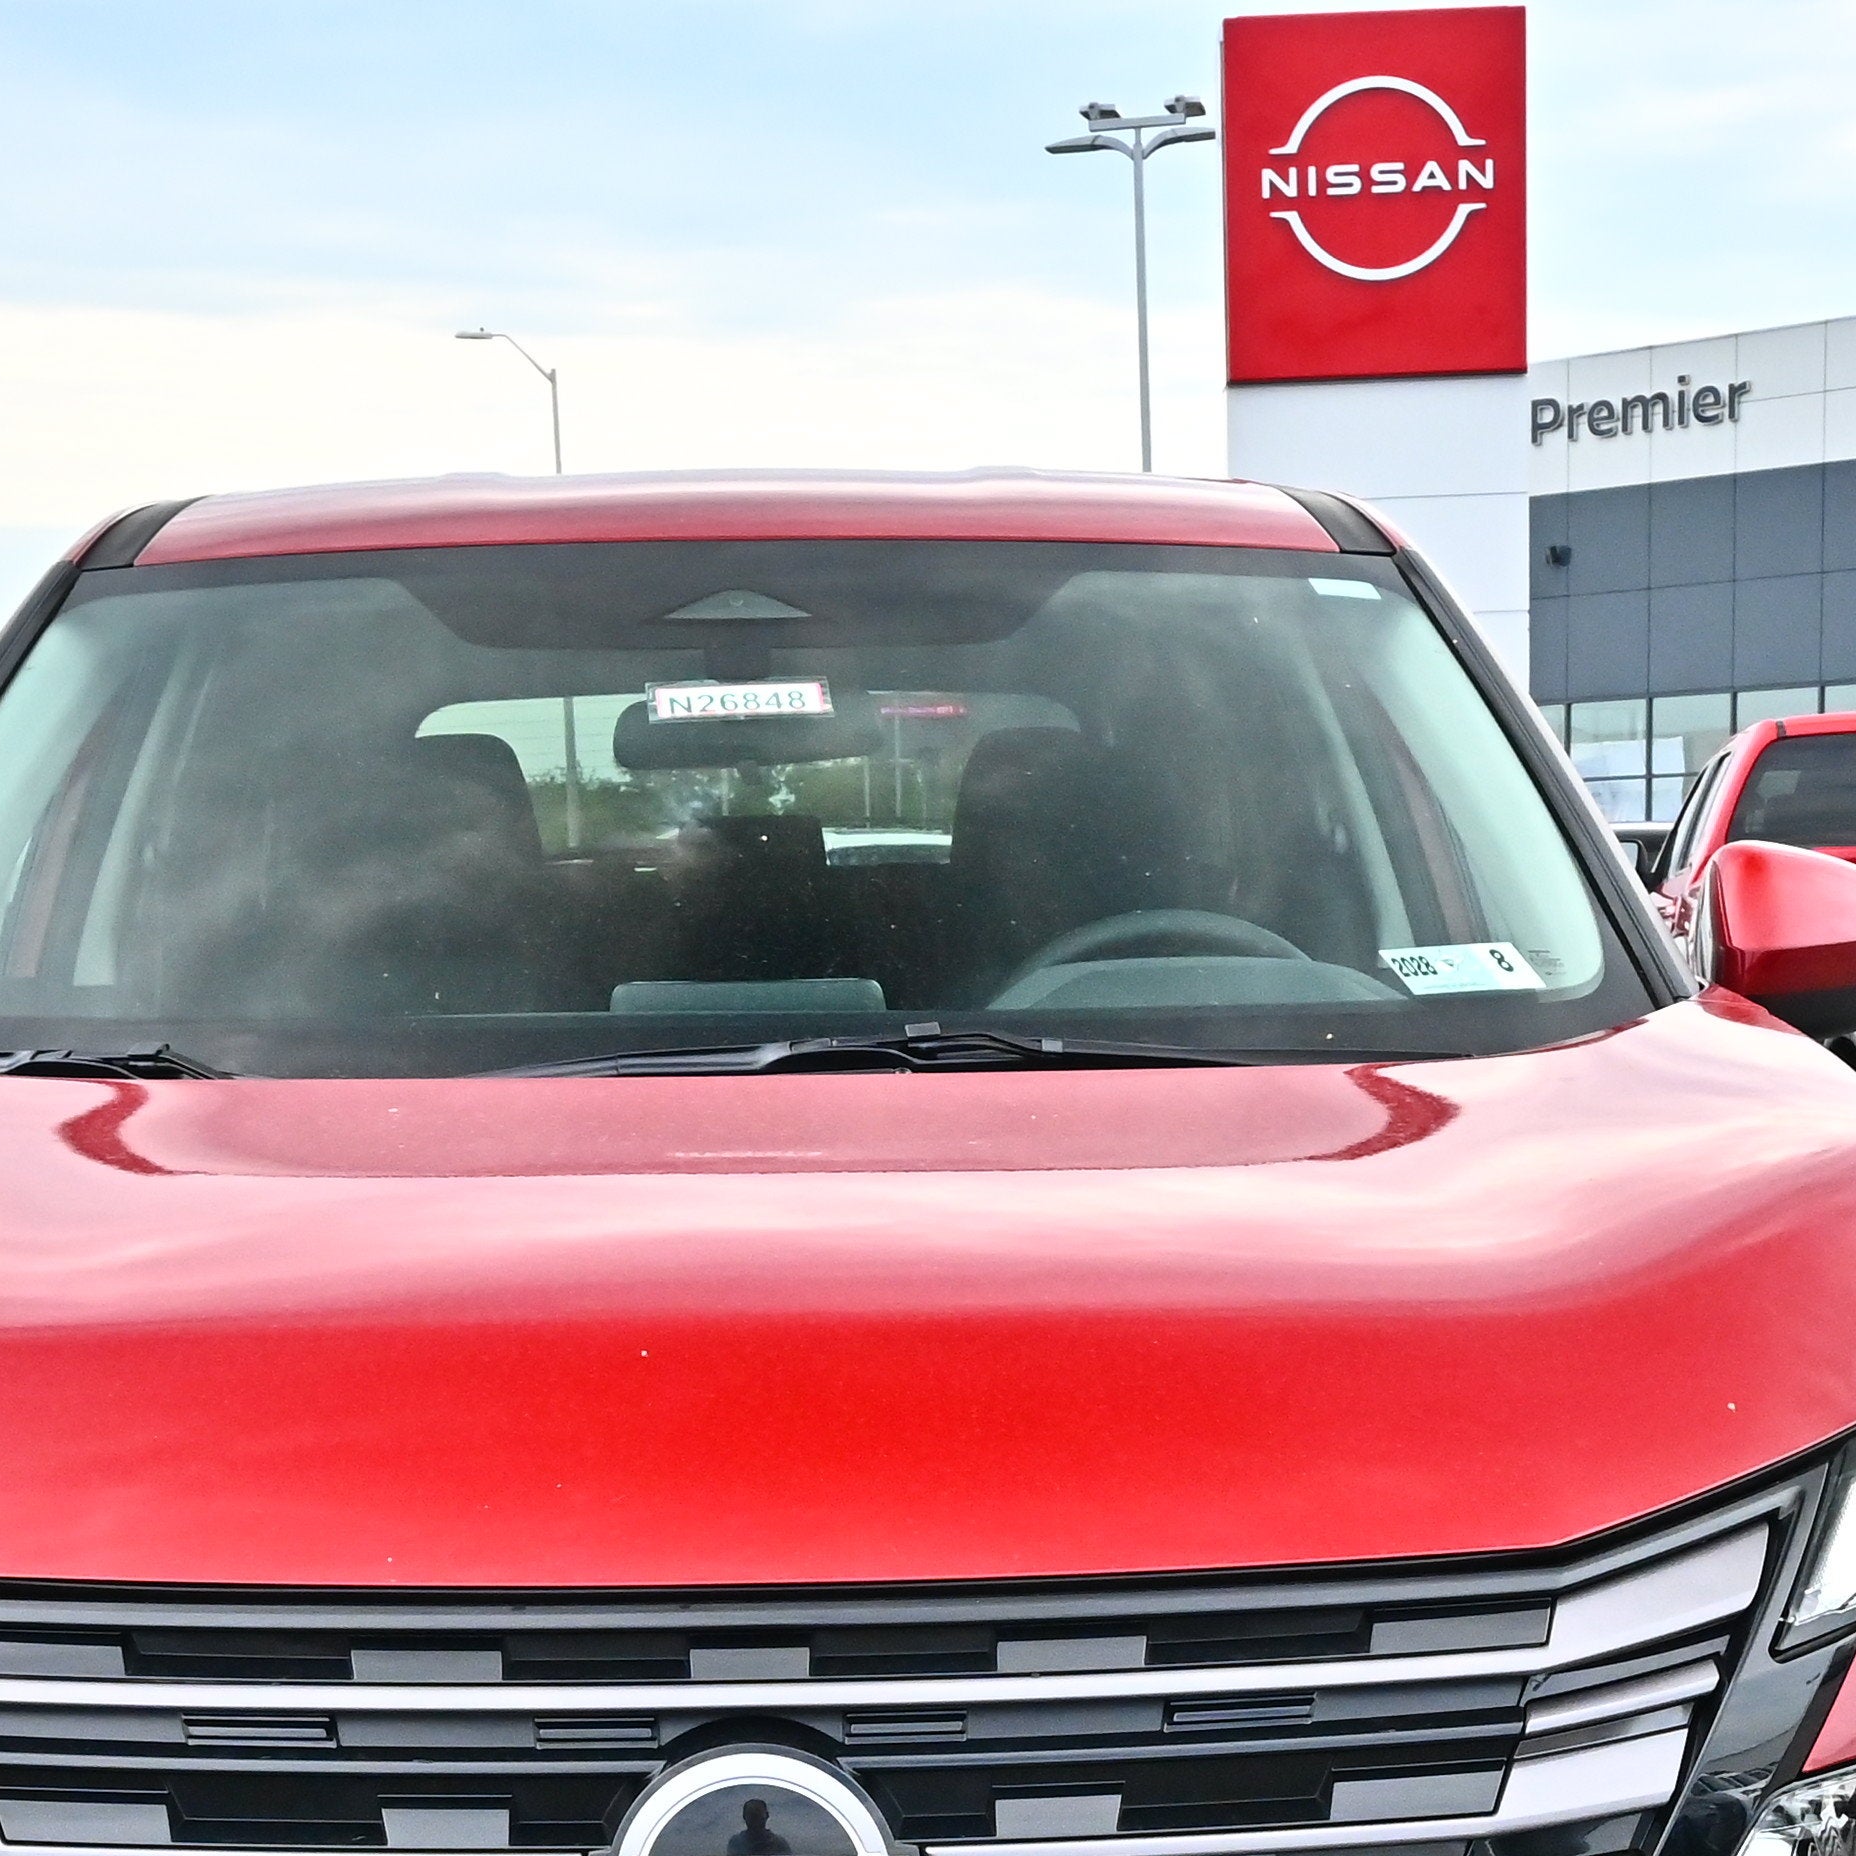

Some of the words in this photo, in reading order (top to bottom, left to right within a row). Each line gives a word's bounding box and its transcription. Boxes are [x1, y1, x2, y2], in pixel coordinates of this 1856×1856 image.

[1261, 158, 1495, 200] NISSAN
[1530, 374, 1752, 446] Premier
[668, 690, 807, 715] N26848
[1390, 955, 1438, 978] 2028
